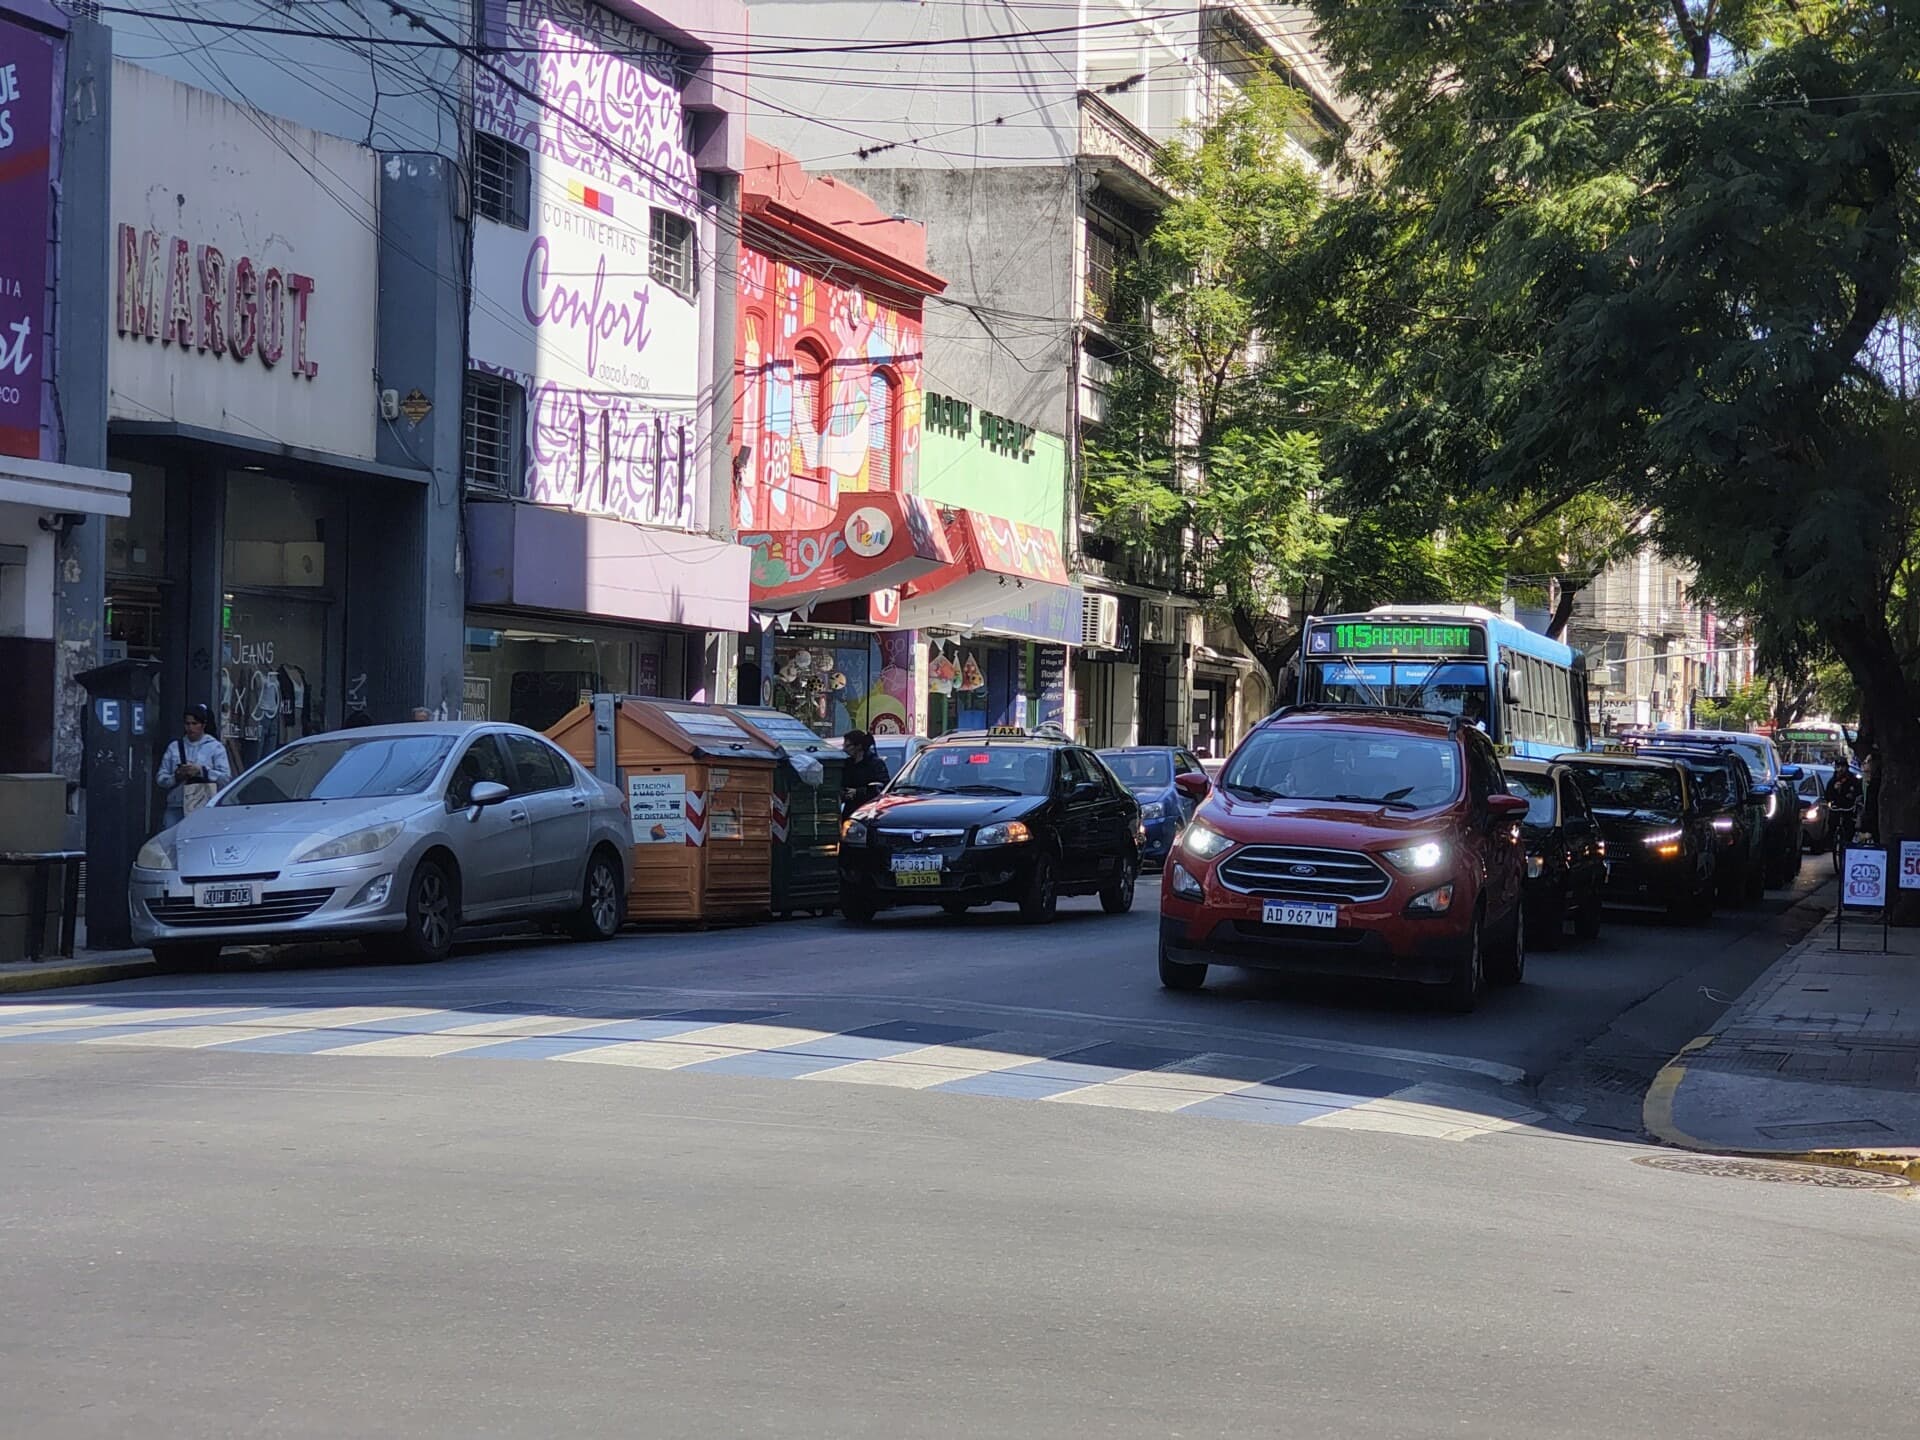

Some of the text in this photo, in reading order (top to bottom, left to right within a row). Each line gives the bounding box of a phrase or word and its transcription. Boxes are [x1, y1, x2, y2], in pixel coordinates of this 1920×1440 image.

[543, 202, 636, 256] CORTINERIAS
[118, 222, 319, 378] MARGOT
[522, 235, 652, 378] Confort
[1335, 624, 1470, 648] 115 AEROPUERTO
[103, 702, 118, 725] E
[134, 707, 143, 730] E
[991, 727, 1021, 735] TAXI
[1606, 745, 1635, 753] TAXI
[204, 888, 250, 904] KUH 603
[1266, 907, 1333, 925] AD 967 VM
